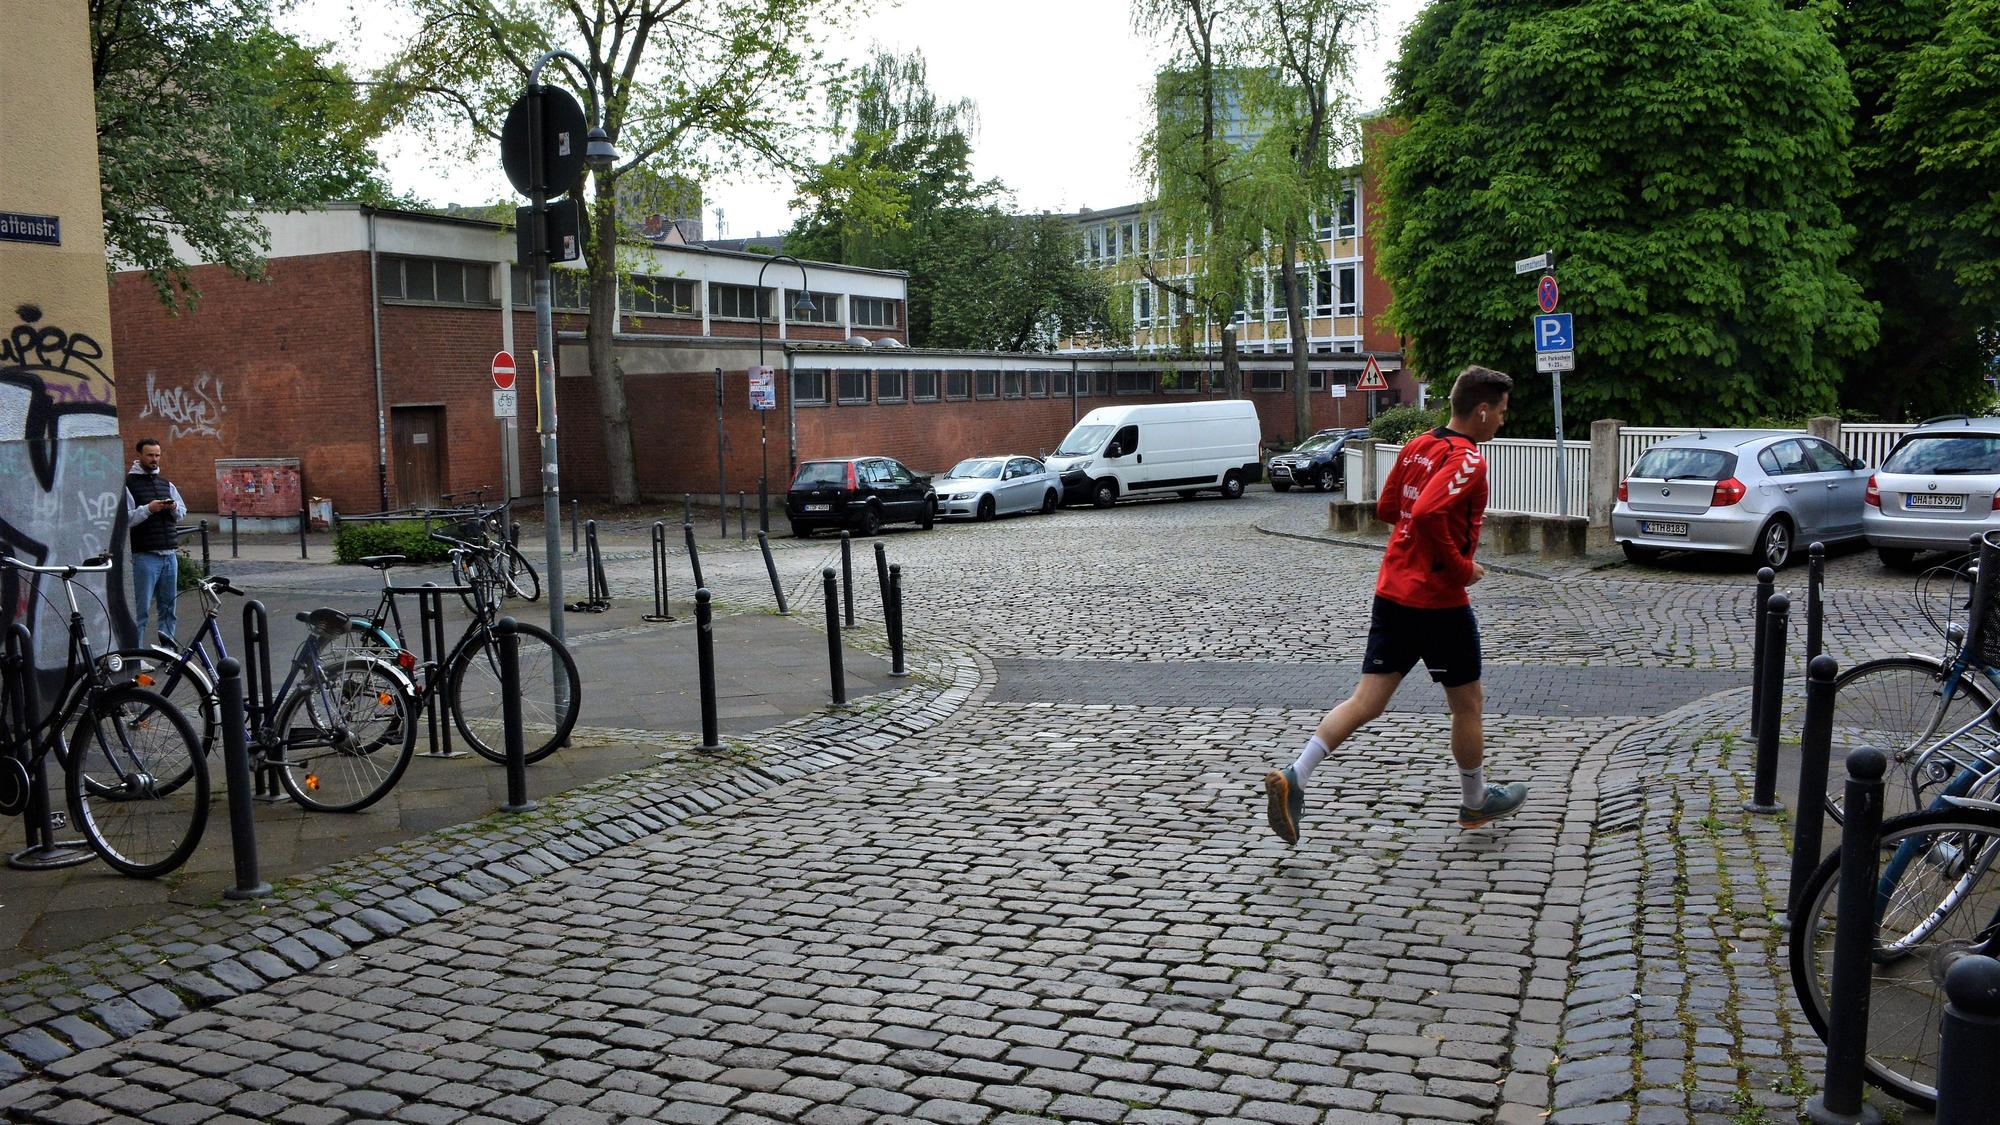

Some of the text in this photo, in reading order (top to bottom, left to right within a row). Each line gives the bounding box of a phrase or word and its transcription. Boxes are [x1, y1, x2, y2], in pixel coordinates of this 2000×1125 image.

[1541, 319, 1560, 346] P
[1912, 495, 1960, 506] OHA TS 990
